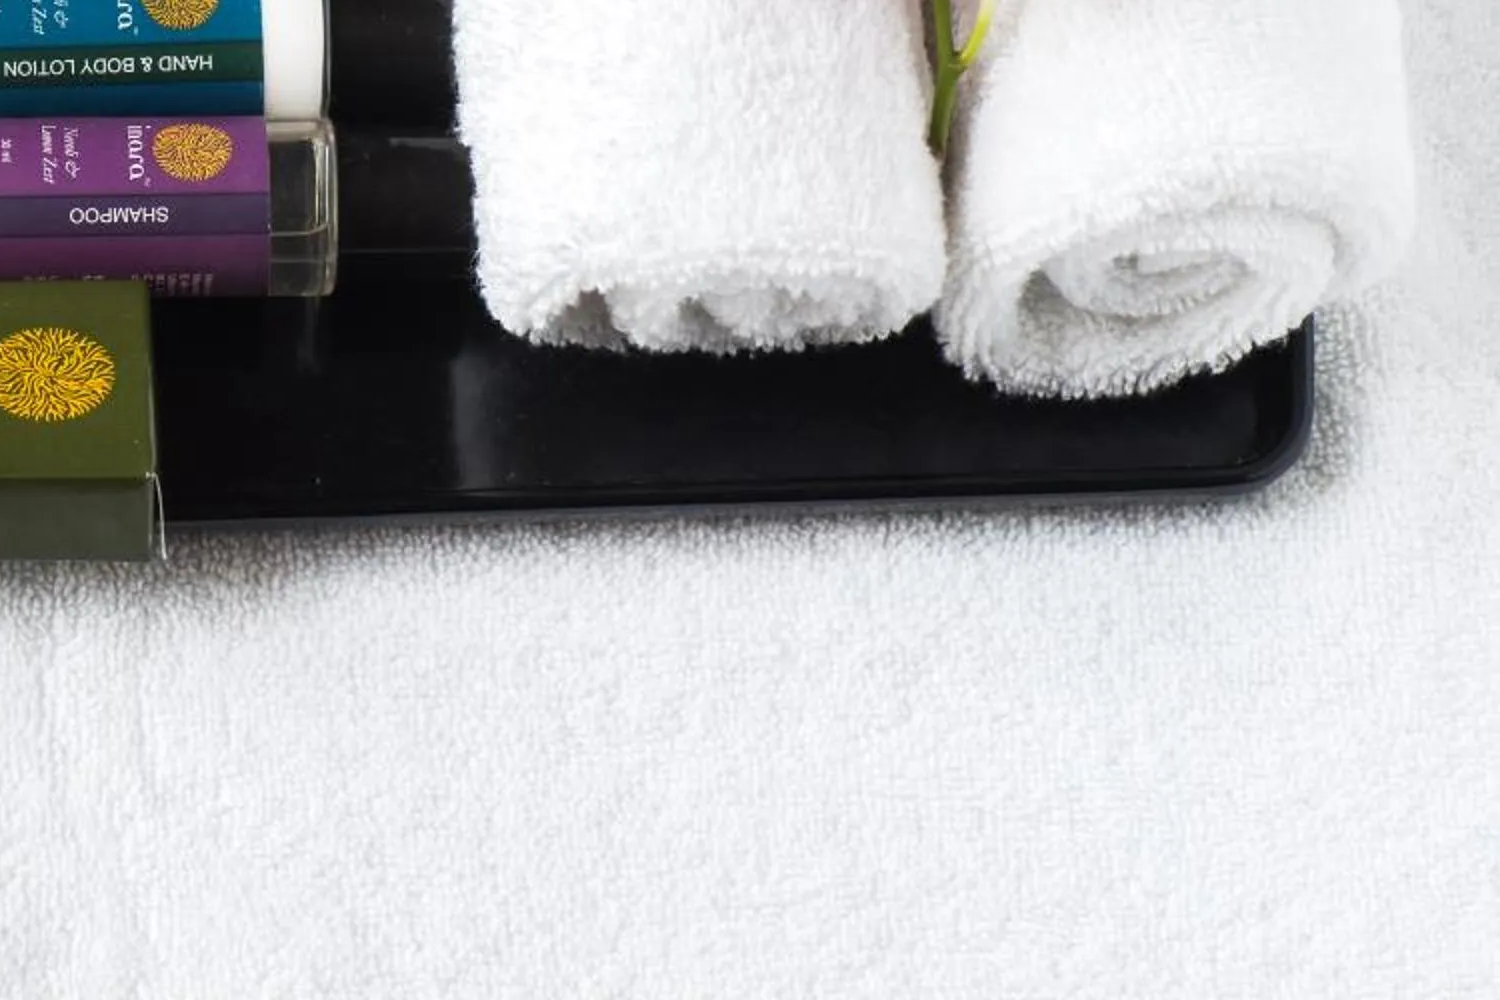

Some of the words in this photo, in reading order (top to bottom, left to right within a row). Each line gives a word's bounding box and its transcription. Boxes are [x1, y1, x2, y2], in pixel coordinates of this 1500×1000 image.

[3, 59, 75, 77] LOTION
[80, 57, 135, 75] BODY
[141, 56, 153, 72] &
[158, 55, 213, 72] HAND
[69, 206, 169, 225] SHAMPOO
